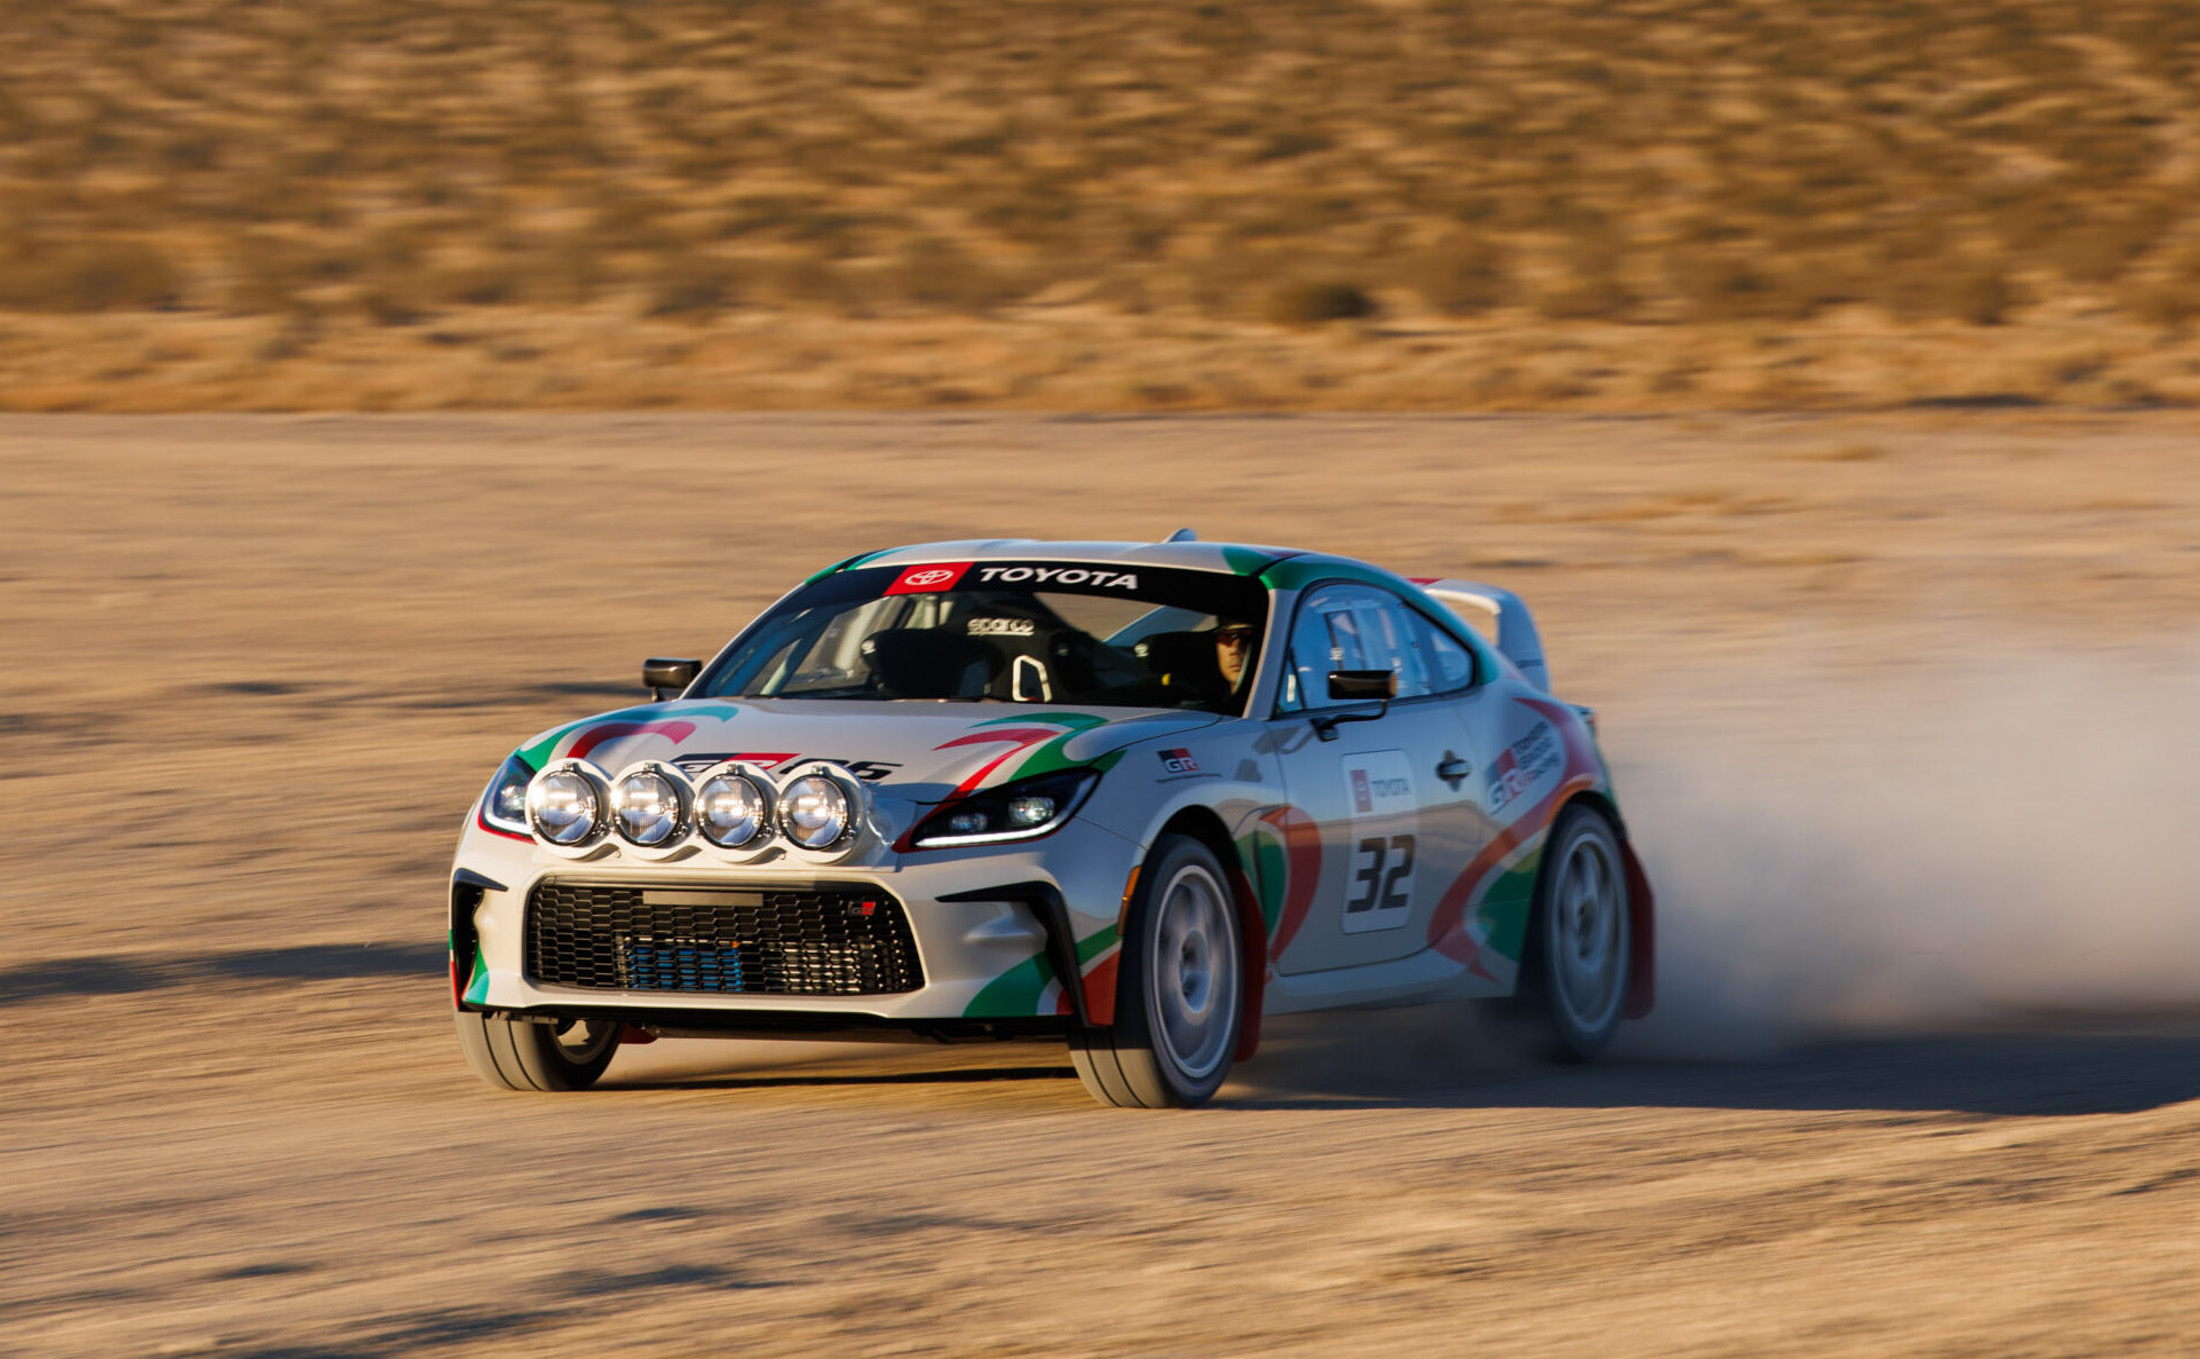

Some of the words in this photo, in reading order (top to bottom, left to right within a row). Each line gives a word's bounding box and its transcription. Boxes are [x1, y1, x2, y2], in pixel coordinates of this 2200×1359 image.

[980, 567, 1138, 590] TOYOTA
[1164, 755, 1199, 773] GR
[1346, 834, 1416, 913] 32
